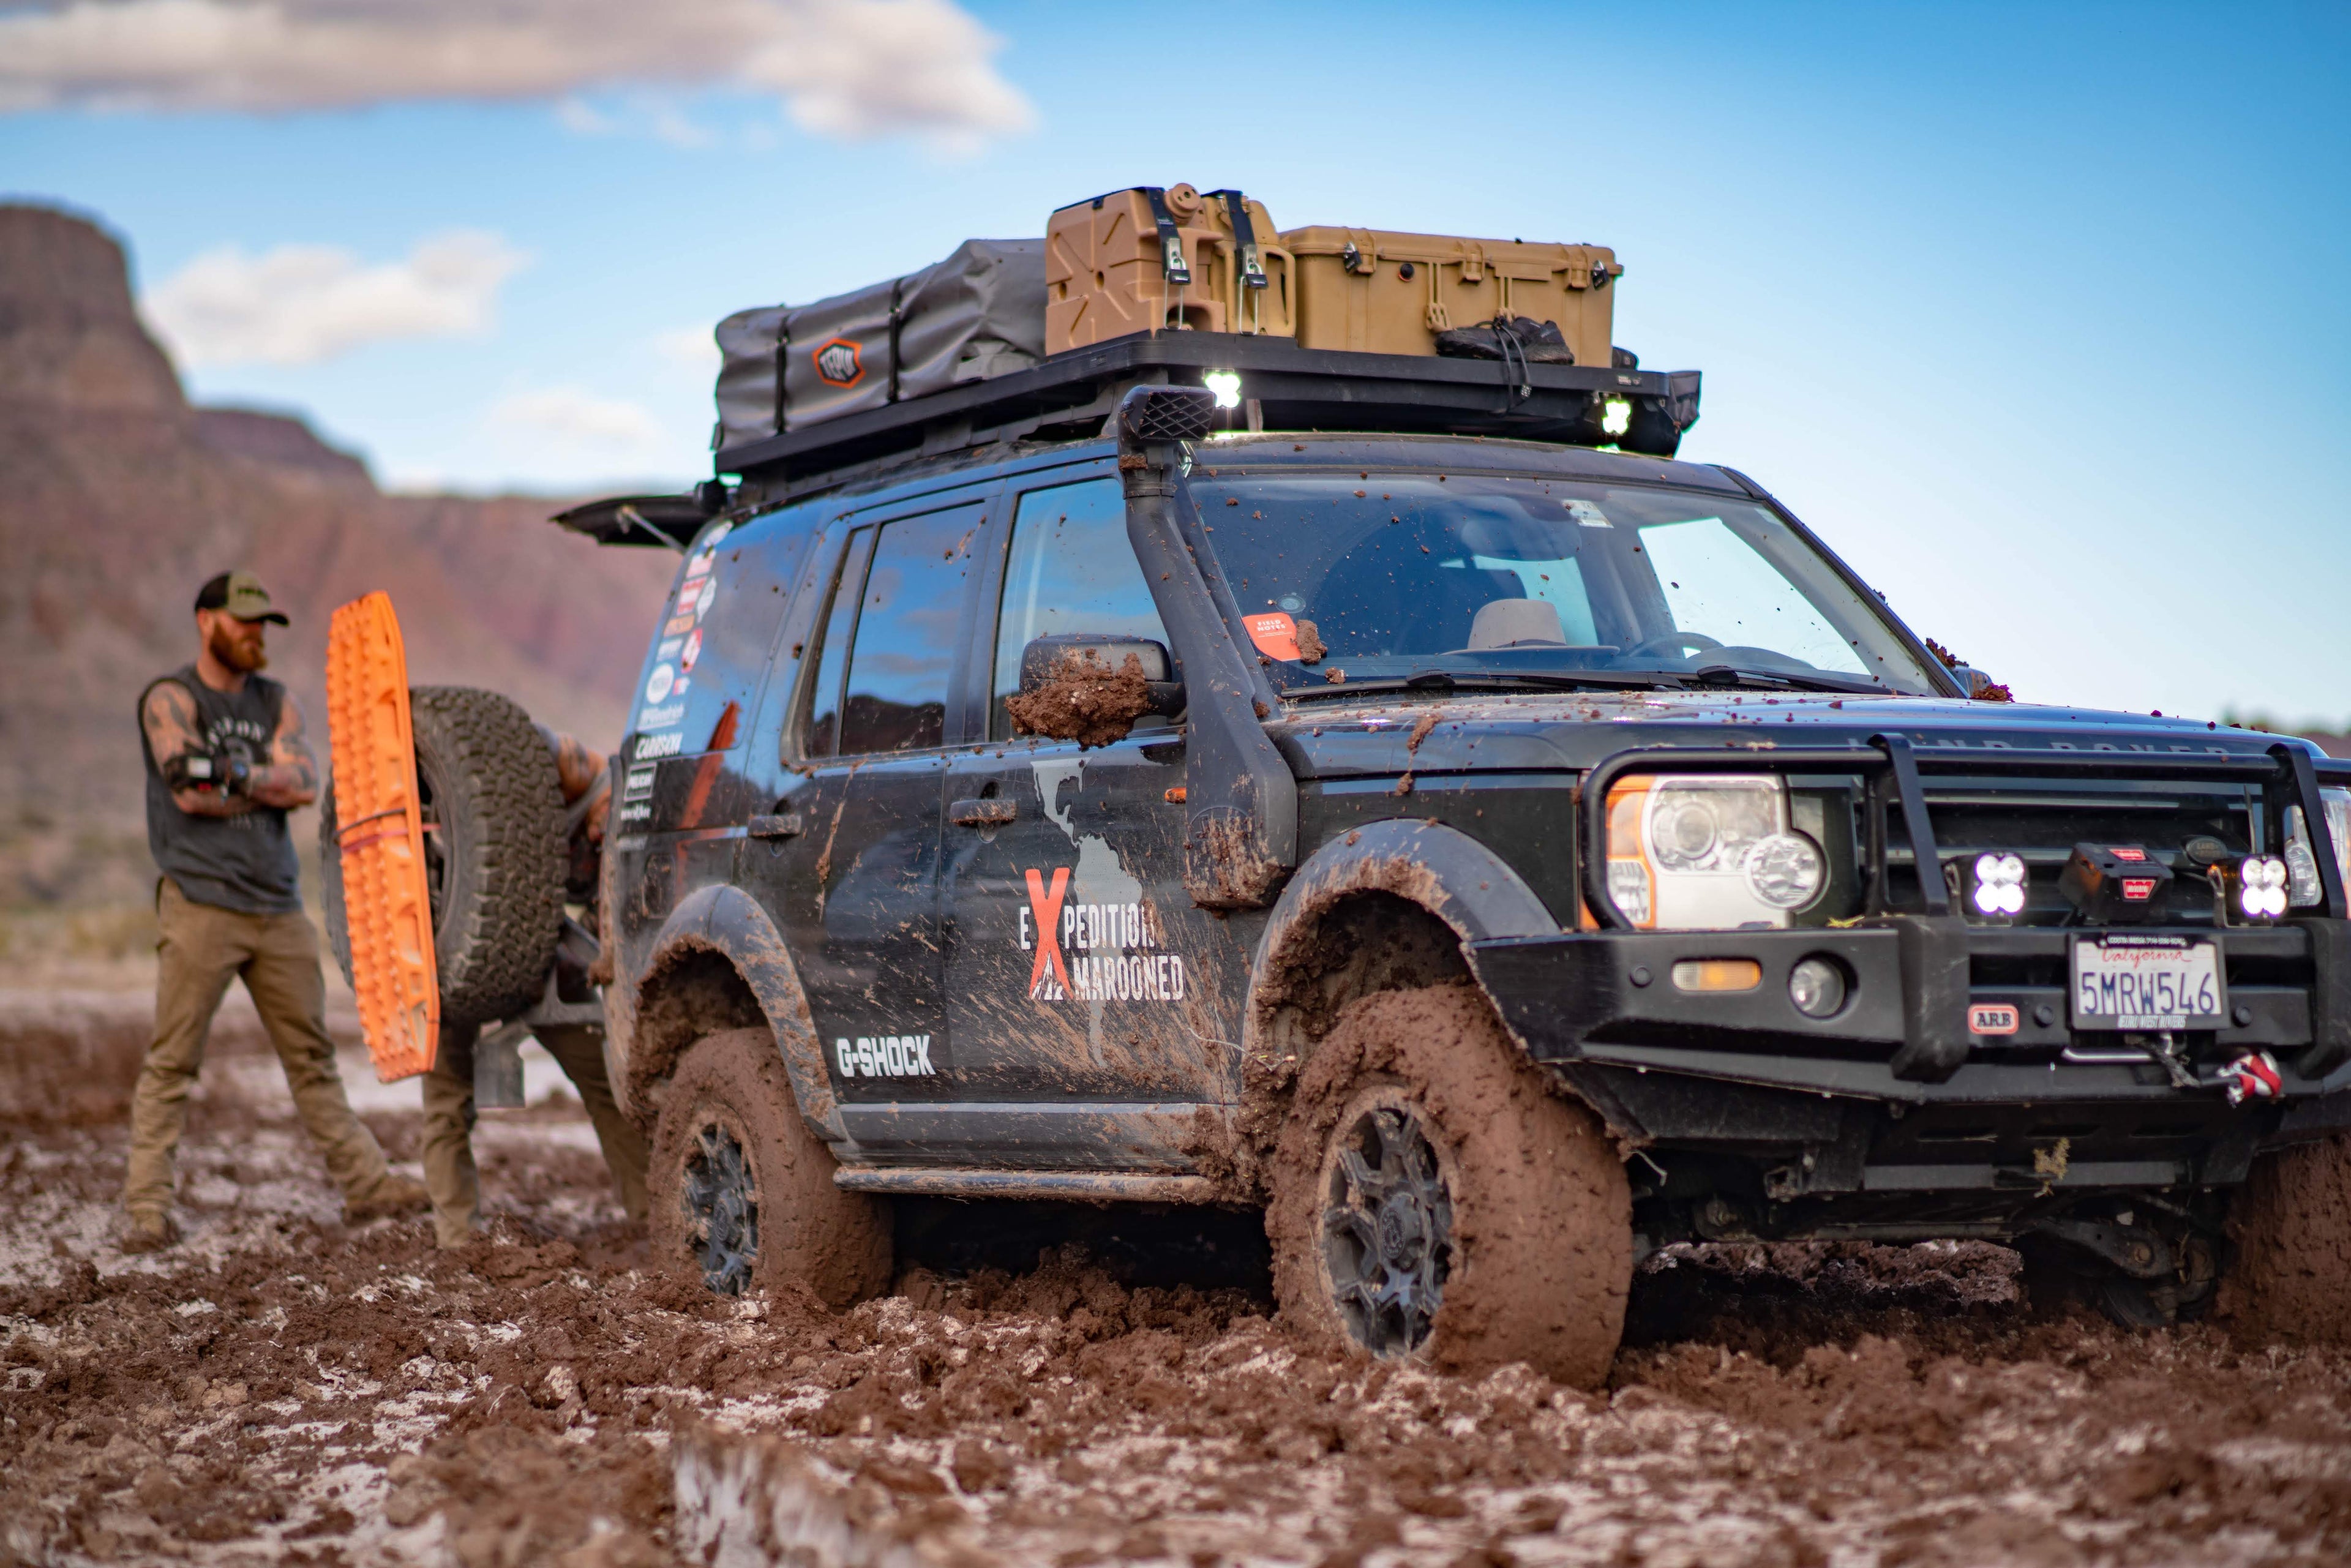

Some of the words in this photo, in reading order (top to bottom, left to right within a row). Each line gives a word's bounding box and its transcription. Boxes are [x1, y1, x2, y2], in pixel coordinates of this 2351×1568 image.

[1073, 955, 1185, 1000] MAROONED
[2102, 948, 2192, 969] California
[2082, 972, 2214, 1015] 5MRW546
[1977, 1012, 2011, 1027] ARB
[836, 1035, 936, 1078] G-SHOCK
